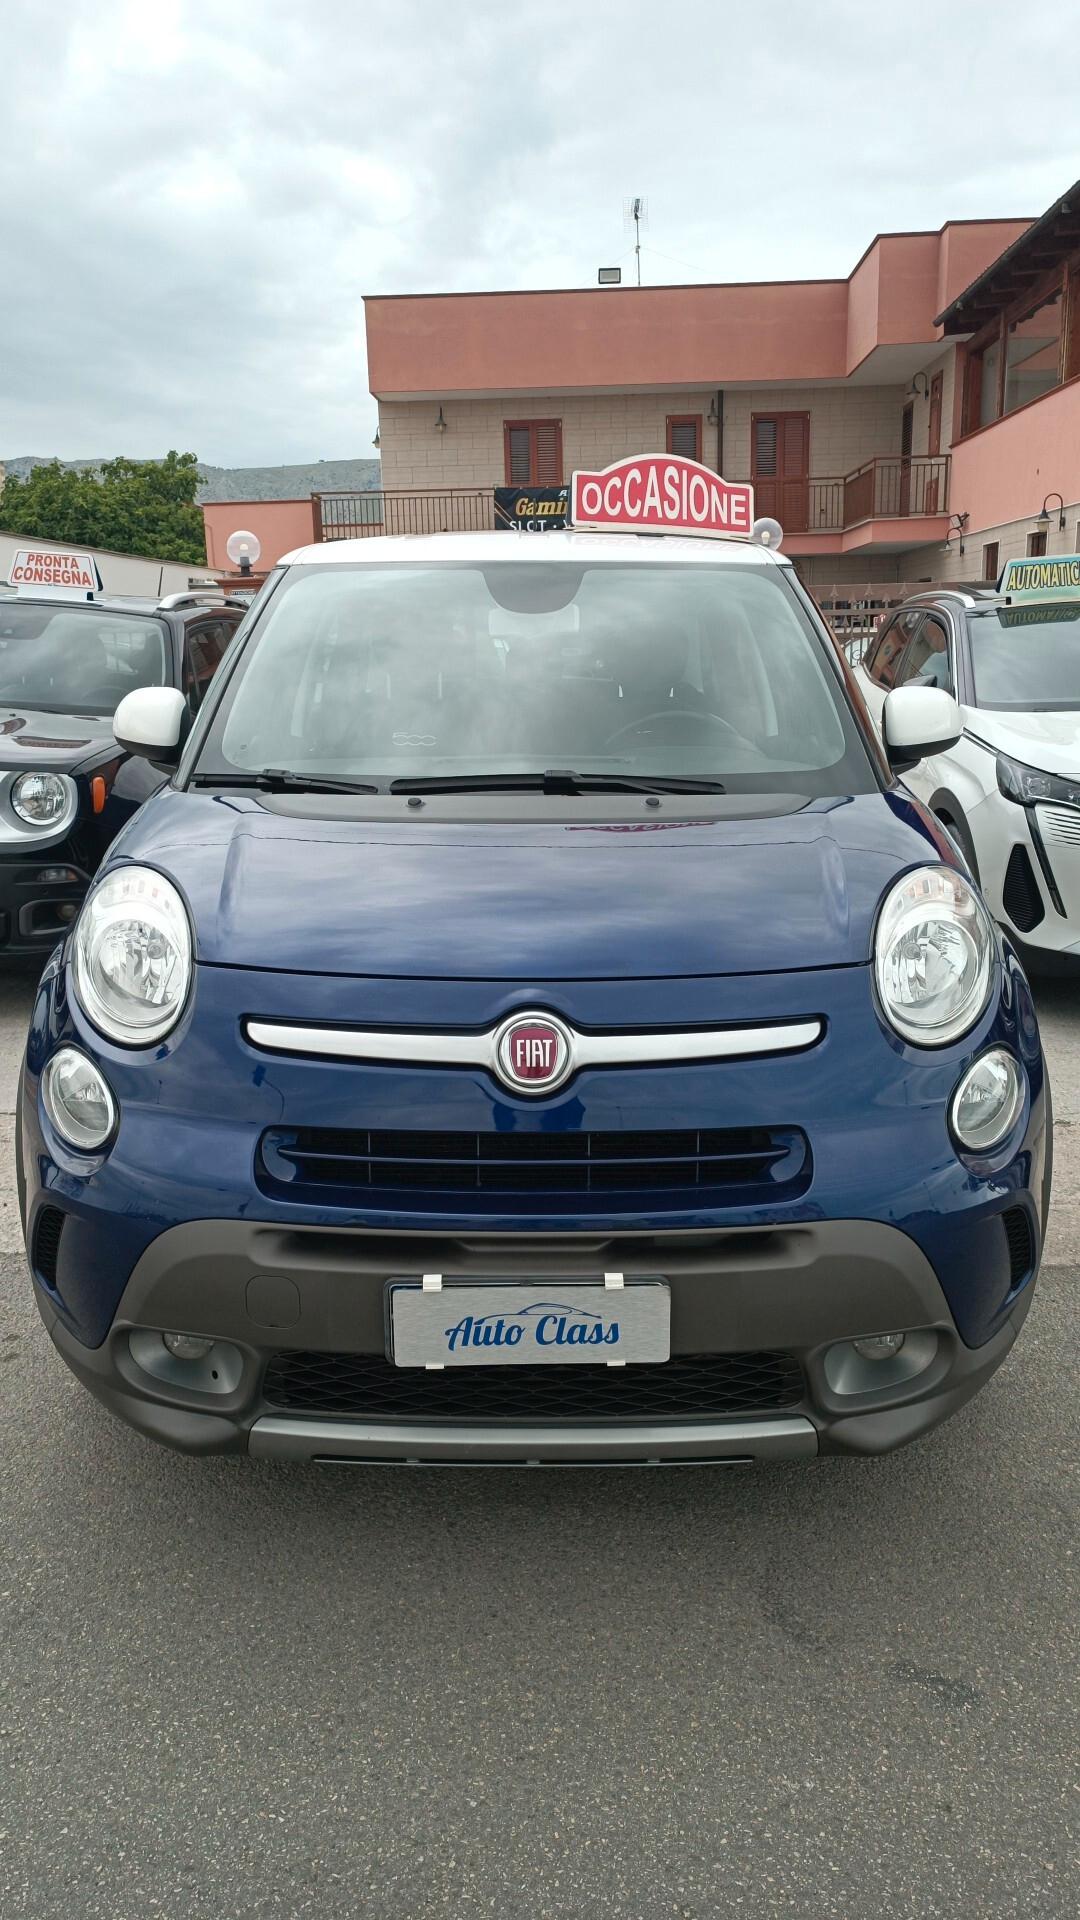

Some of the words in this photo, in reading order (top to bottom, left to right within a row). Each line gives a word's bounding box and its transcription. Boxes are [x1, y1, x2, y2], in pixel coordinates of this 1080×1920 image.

[581, 465, 747, 526] OCCASIONE
[509, 520, 547, 532] SLOT
[26, 554, 79, 569] PRONTA
[13, 566, 92, 586] CONSEGNA
[516, 1039, 553, 1068] FIAT
[445, 1316, 525, 1351] Auto
[535, 1315, 620, 1346] Class
